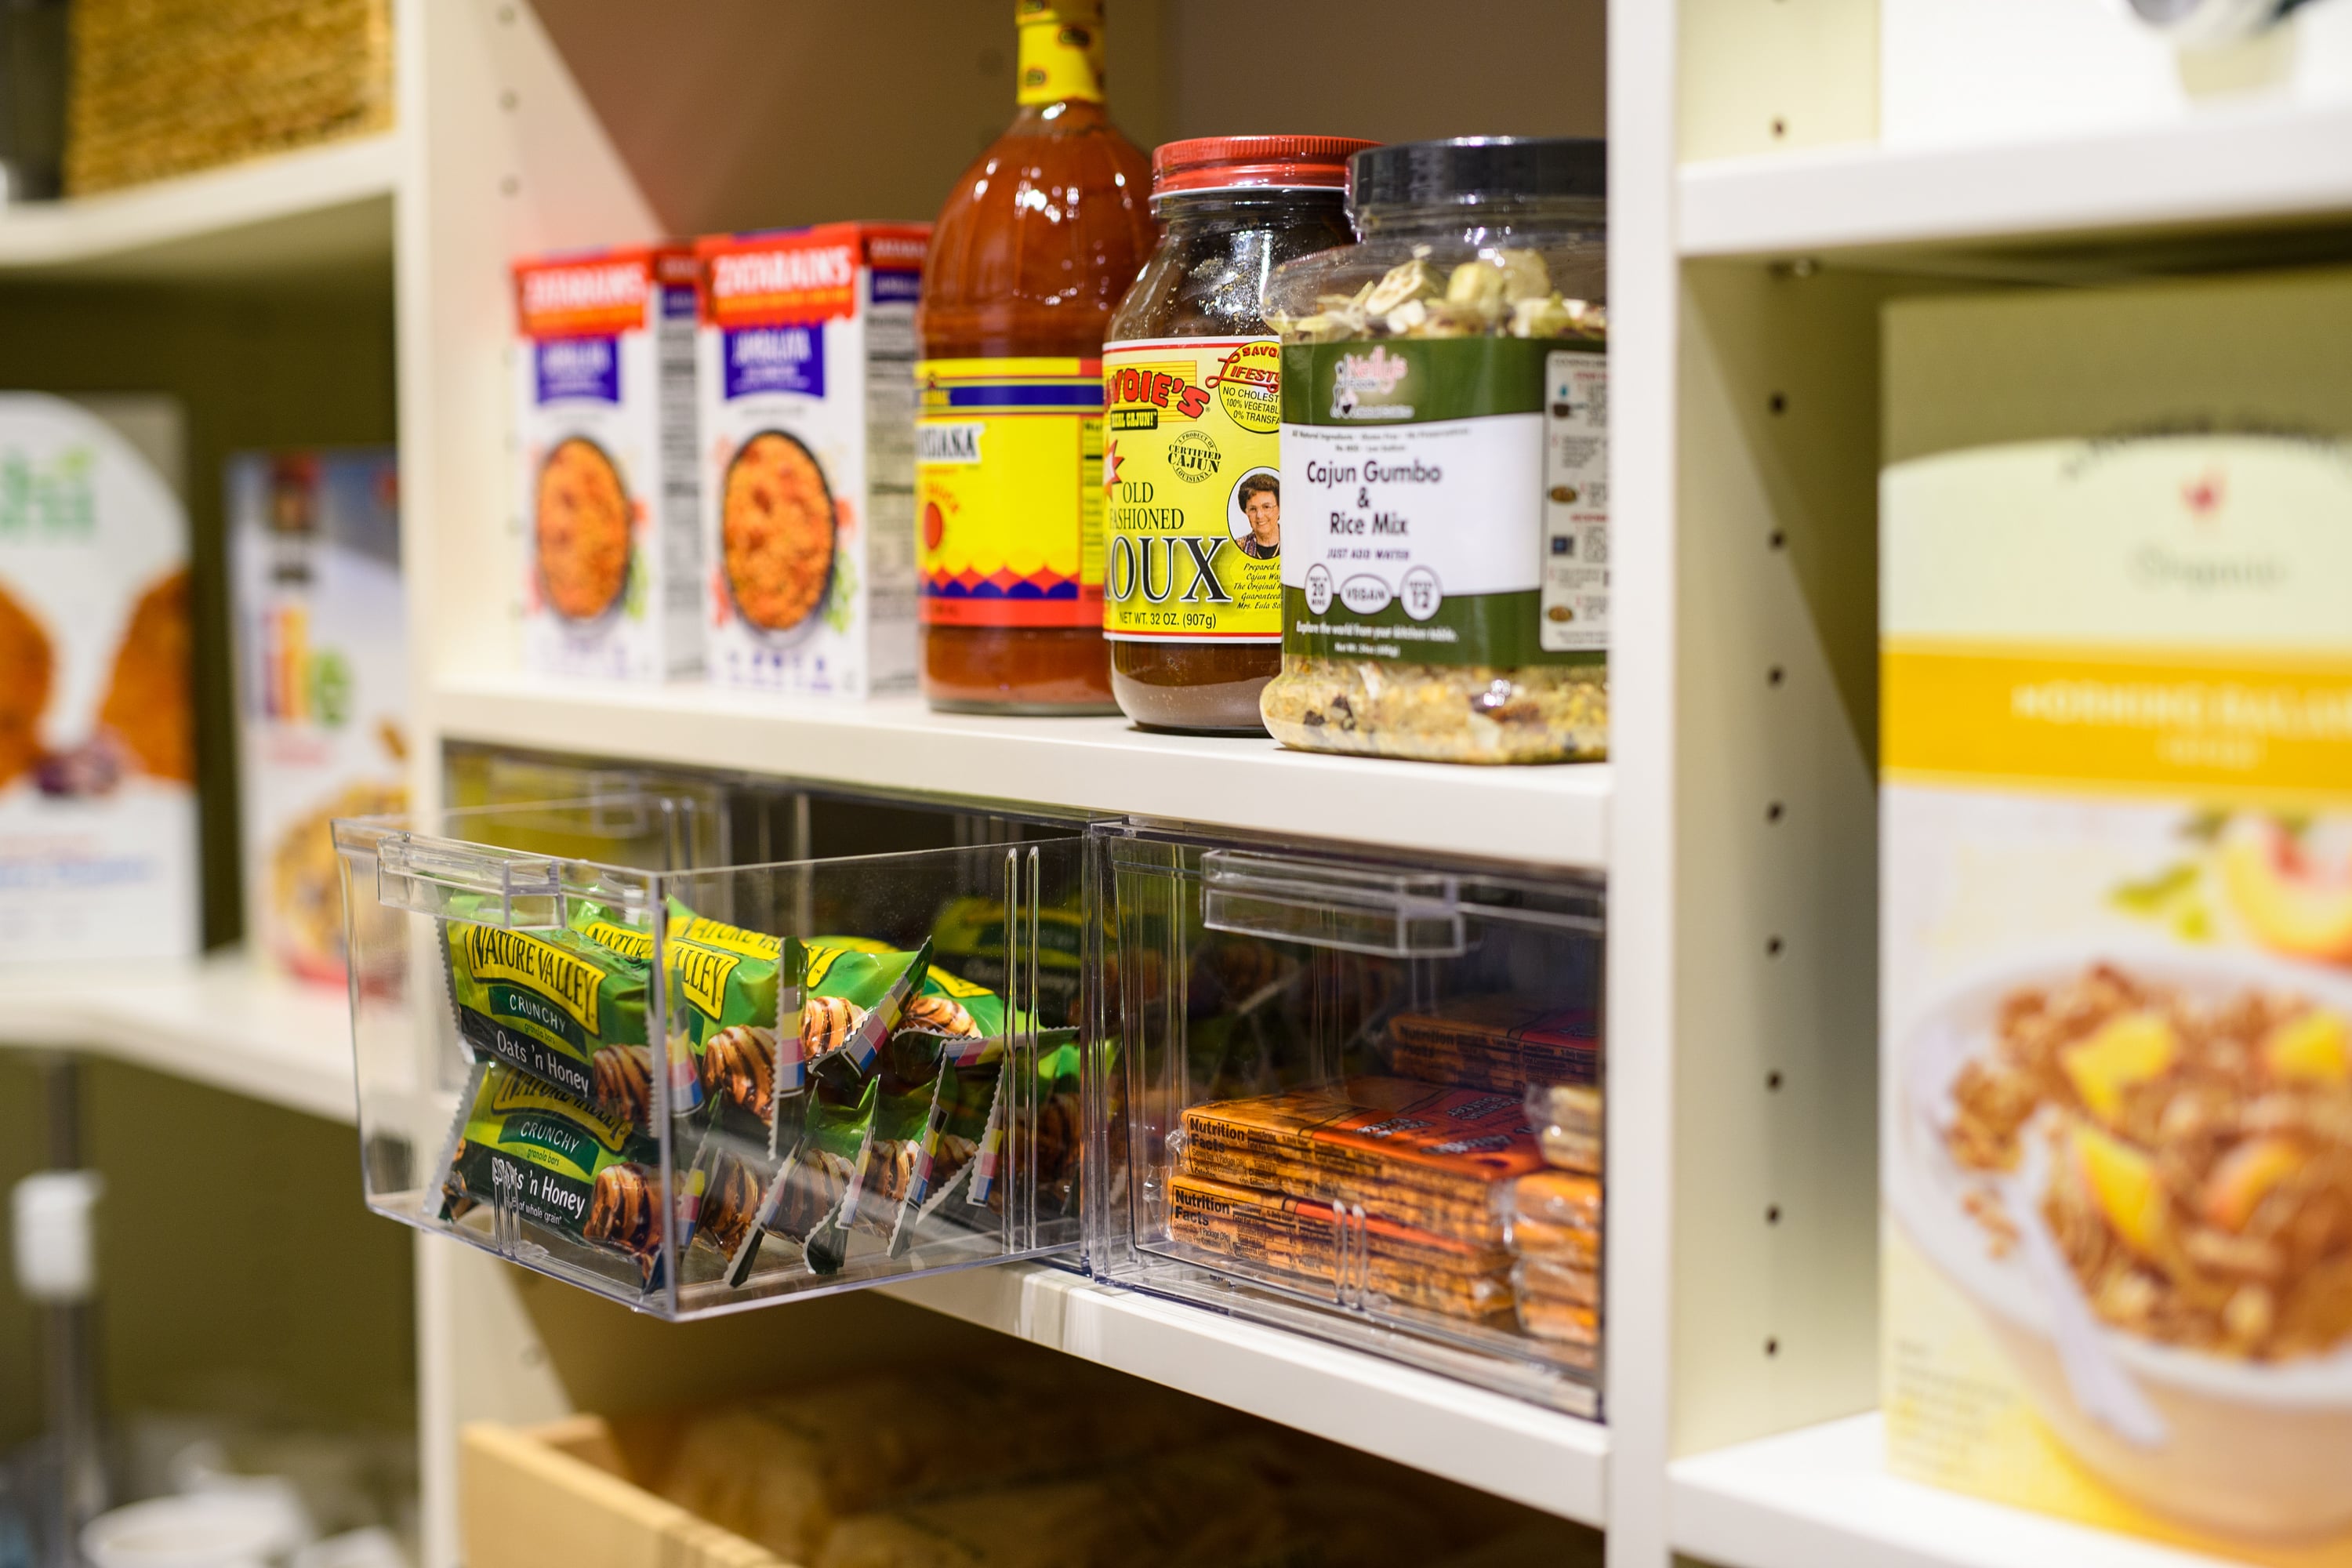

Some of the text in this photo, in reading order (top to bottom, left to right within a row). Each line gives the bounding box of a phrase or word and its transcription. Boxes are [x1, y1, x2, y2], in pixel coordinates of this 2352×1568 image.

[1105, 368, 1210, 419] AVOIE'S
[1223, 386, 1279, 403] NO CHOLEST
[1226, 398, 1279, 415] 100% VEGETABL
[1233, 410, 1279, 425] 0% TRANSFA
[1182, 432, 1207, 441] PRODUCT
[1208, 440, 1214, 448] OF
[1169, 444, 1221, 460] CERTIFIED
[1168, 452, 1221, 473] CAJUN
[1176, 467, 1209, 483] LOUISIANA
[1307, 459, 1442, 488] Cajun Gumbo
[1123, 481, 1153, 503] OLD
[1357, 487, 1370, 508] &
[1109, 508, 1184, 530] FASHIONED
[1330, 512, 1409, 535] Rice Mix
[1104, 535, 1233, 604] OUX
[1243, 563, 1276, 572] Prepared
[1246, 573, 1266, 582] Cajun
[1247, 583, 1276, 592] Original
[1312, 583, 1324, 597] 20
[1345, 588, 1386, 601] VEGAN
[1412, 590, 1428, 609] 12
[1120, 612, 1216, 629] NET WT. 32 OZ. (907g)
[590, 926, 644, 960] NATUR
[472, 925, 597, 1024] NATURE VALLEY
[510, 994, 566, 1033] CRUNCHY
[497, 1030, 589, 1098] Oats 'n Honey
[520, 1121, 579, 1154] CRUNCHY
[1189, 1117, 1245, 1142] Nutrition
[1191, 1134, 1225, 1153] Facts
[527, 1149, 560, 1167] granola bars
[529, 1169, 539, 1196] 'n
[542, 1175, 586, 1220] Honey
[1175, 1189, 1230, 1214] Nutrition
[518, 1201, 524, 1210] of
[525, 1204, 543, 1218] whole
[1175, 1207, 1209, 1226] Facts
[1203, 1228, 1218, 1240] Package
